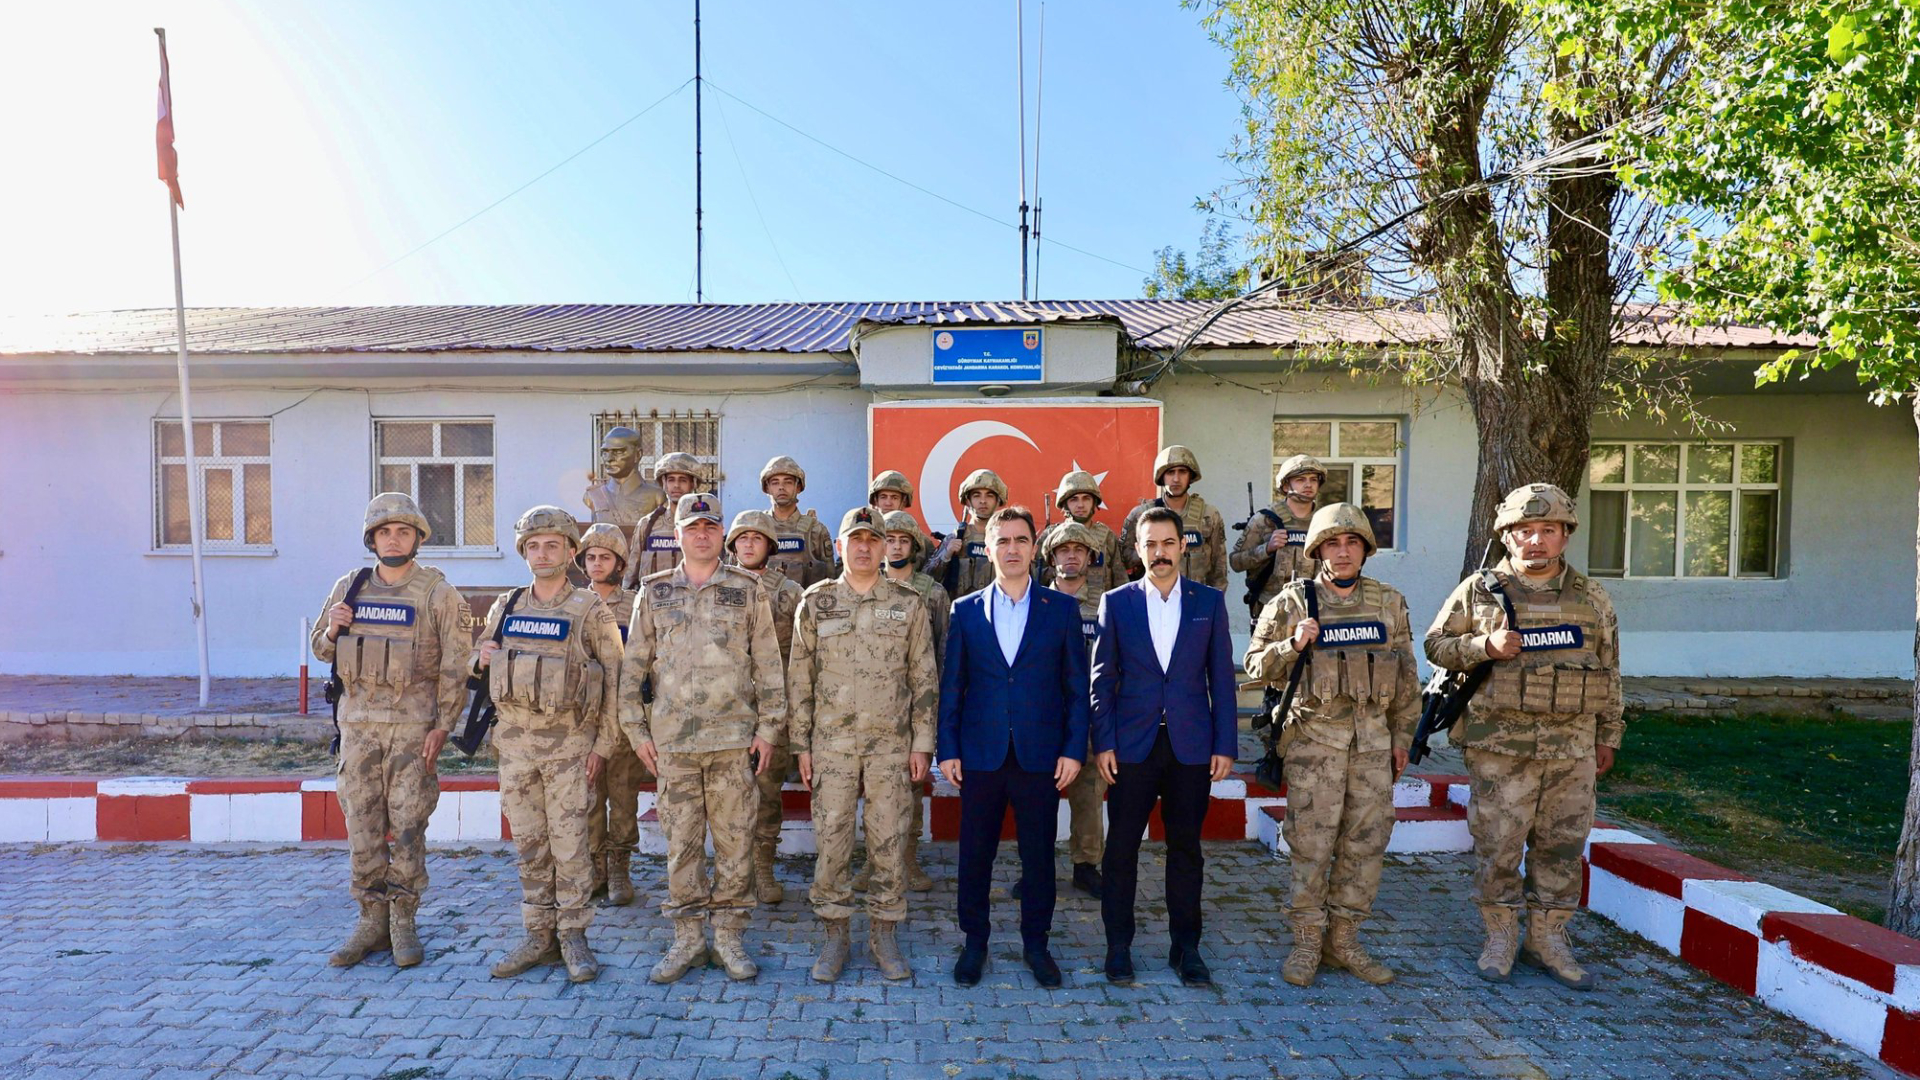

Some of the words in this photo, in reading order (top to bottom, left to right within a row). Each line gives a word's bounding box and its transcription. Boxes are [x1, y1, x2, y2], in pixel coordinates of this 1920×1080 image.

[355, 606, 407, 622] JANDARMA
[508, 620, 560, 636] JANDARMA
[1323, 626, 1381, 642] JANDARMA
